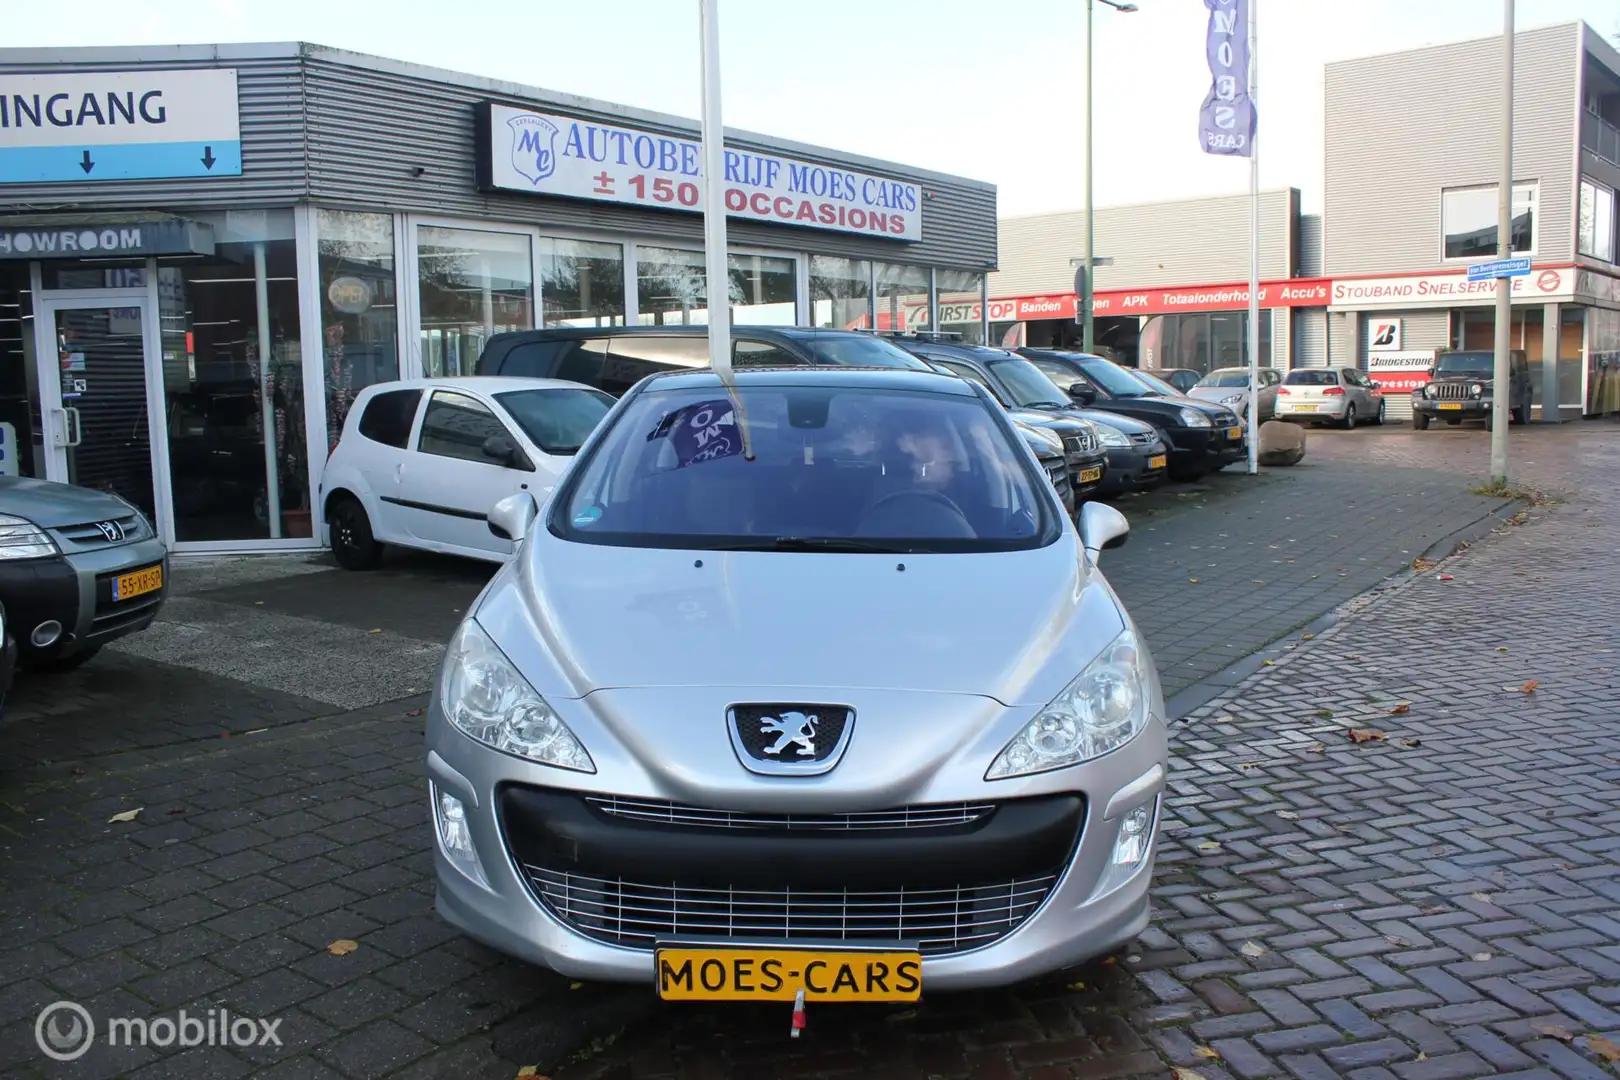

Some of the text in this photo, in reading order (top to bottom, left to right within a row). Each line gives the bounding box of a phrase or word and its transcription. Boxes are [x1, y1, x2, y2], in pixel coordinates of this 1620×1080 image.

[0, 90, 167, 128] INGANG
[562, 122, 917, 213] AUTOBERIJF MOES CARS
[628, 174, 700, 206] 150
[725, 188, 906, 234] OCCASIONS
[0, 229, 141, 254] HOWROOM
[1020, 301, 1061, 314] Banden
[1122, 295, 1148, 307] APK
[1162, 288, 1266, 305] Totaalonderhod
[1280, 285, 1327, 300] Accu's
[1334, 280, 1412, 300] STOUBAND
[1417, 278, 1523, 296] SNELSERVE
[1371, 357, 1433, 367] BRIDGESTONE
[121, 569, 161, 596] 55-XR-SP
[661, 957, 920, 994] MOES-CARS
